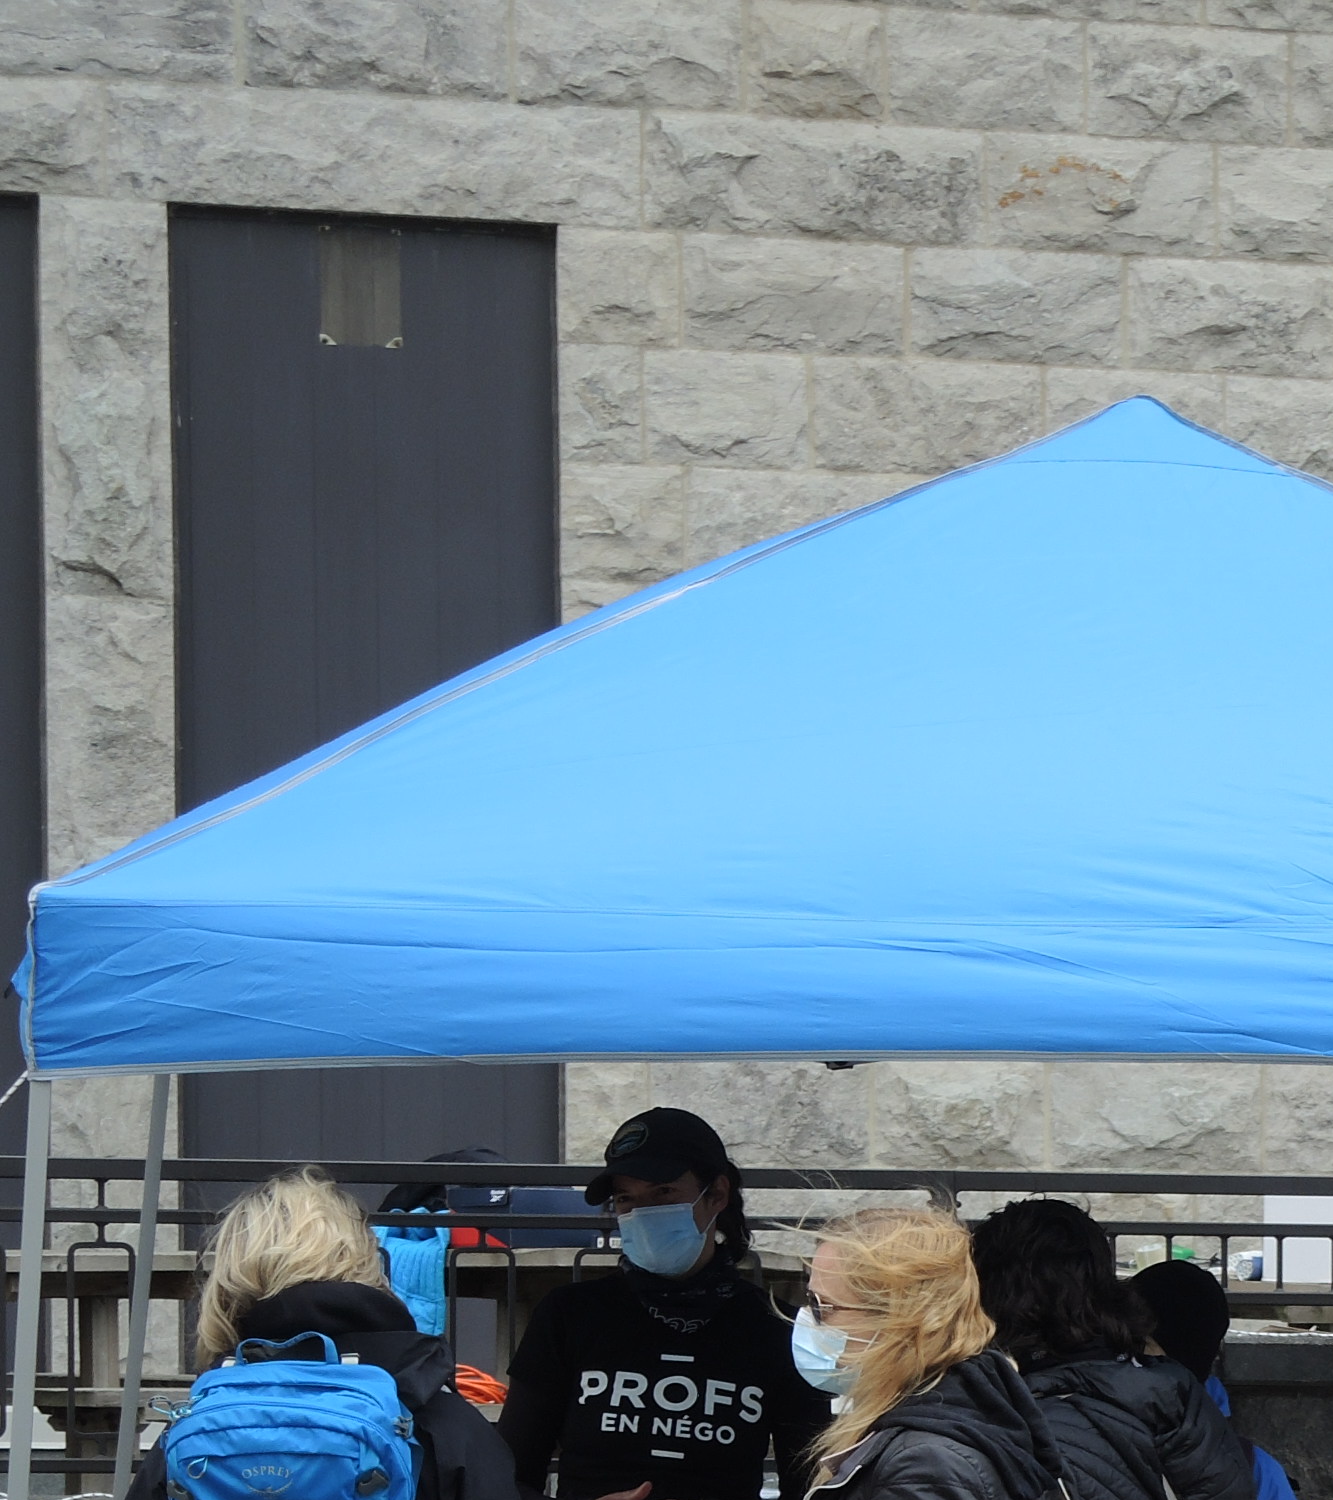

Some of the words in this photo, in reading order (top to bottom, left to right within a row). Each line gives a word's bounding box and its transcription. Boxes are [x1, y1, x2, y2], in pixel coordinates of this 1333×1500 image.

[578, 1370, 764, 1423] PROFS
[600, 1412, 640, 1434] EN
[651, 1415, 736, 1445] NÉGO
